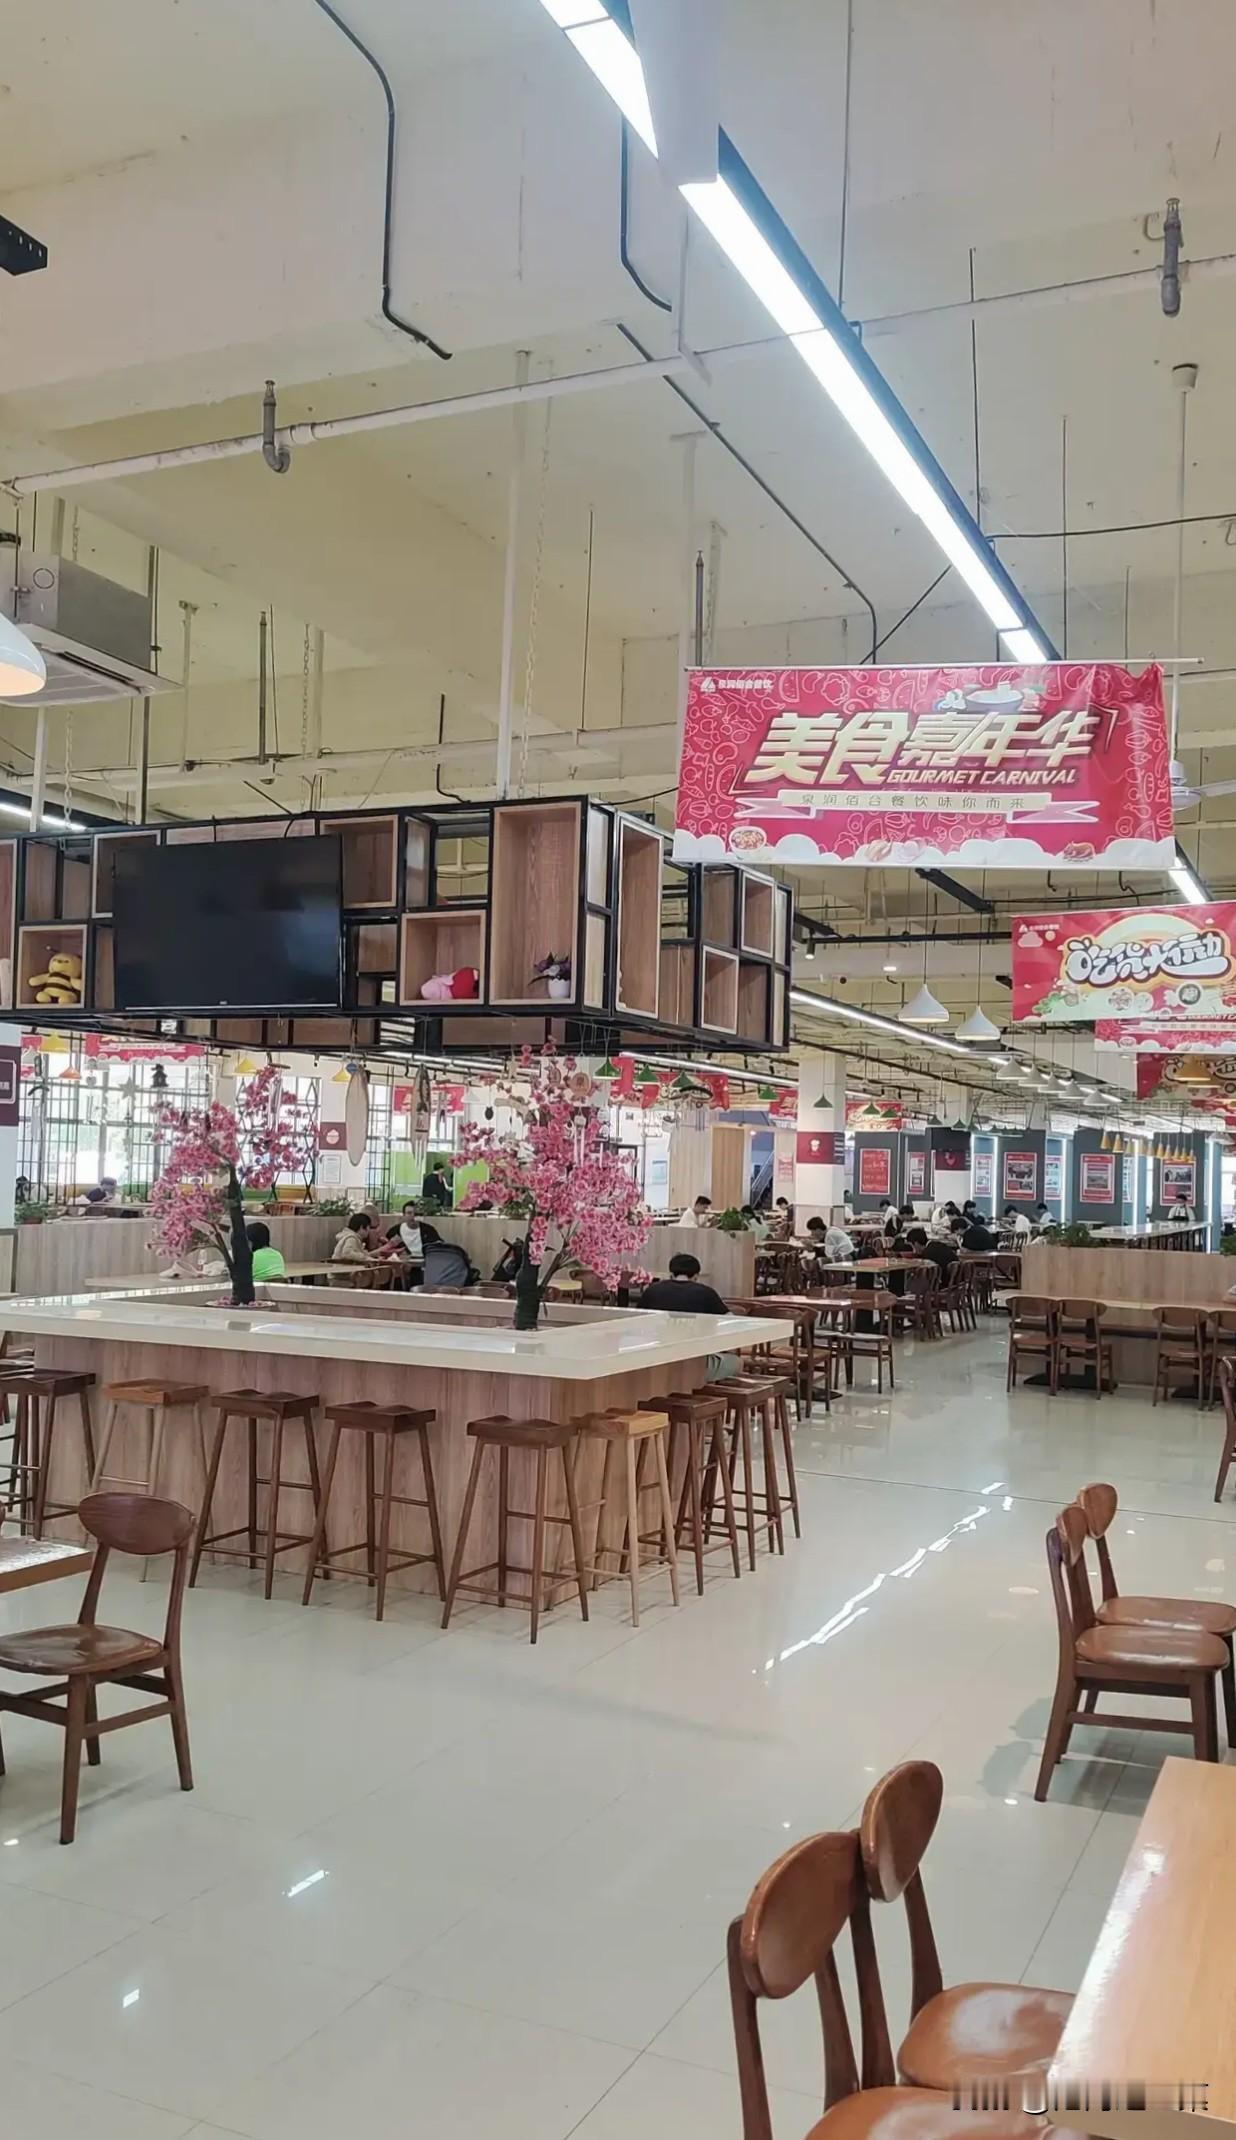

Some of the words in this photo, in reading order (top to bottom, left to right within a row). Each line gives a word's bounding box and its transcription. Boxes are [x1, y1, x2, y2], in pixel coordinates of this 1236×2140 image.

[745, 711, 1100, 784] 美食嘉年华
[887, 769, 979, 784] GOURMET
[982, 769, 1075, 784] CARNIVAL
[1066, 932, 1229, 985] 吃货大行动
